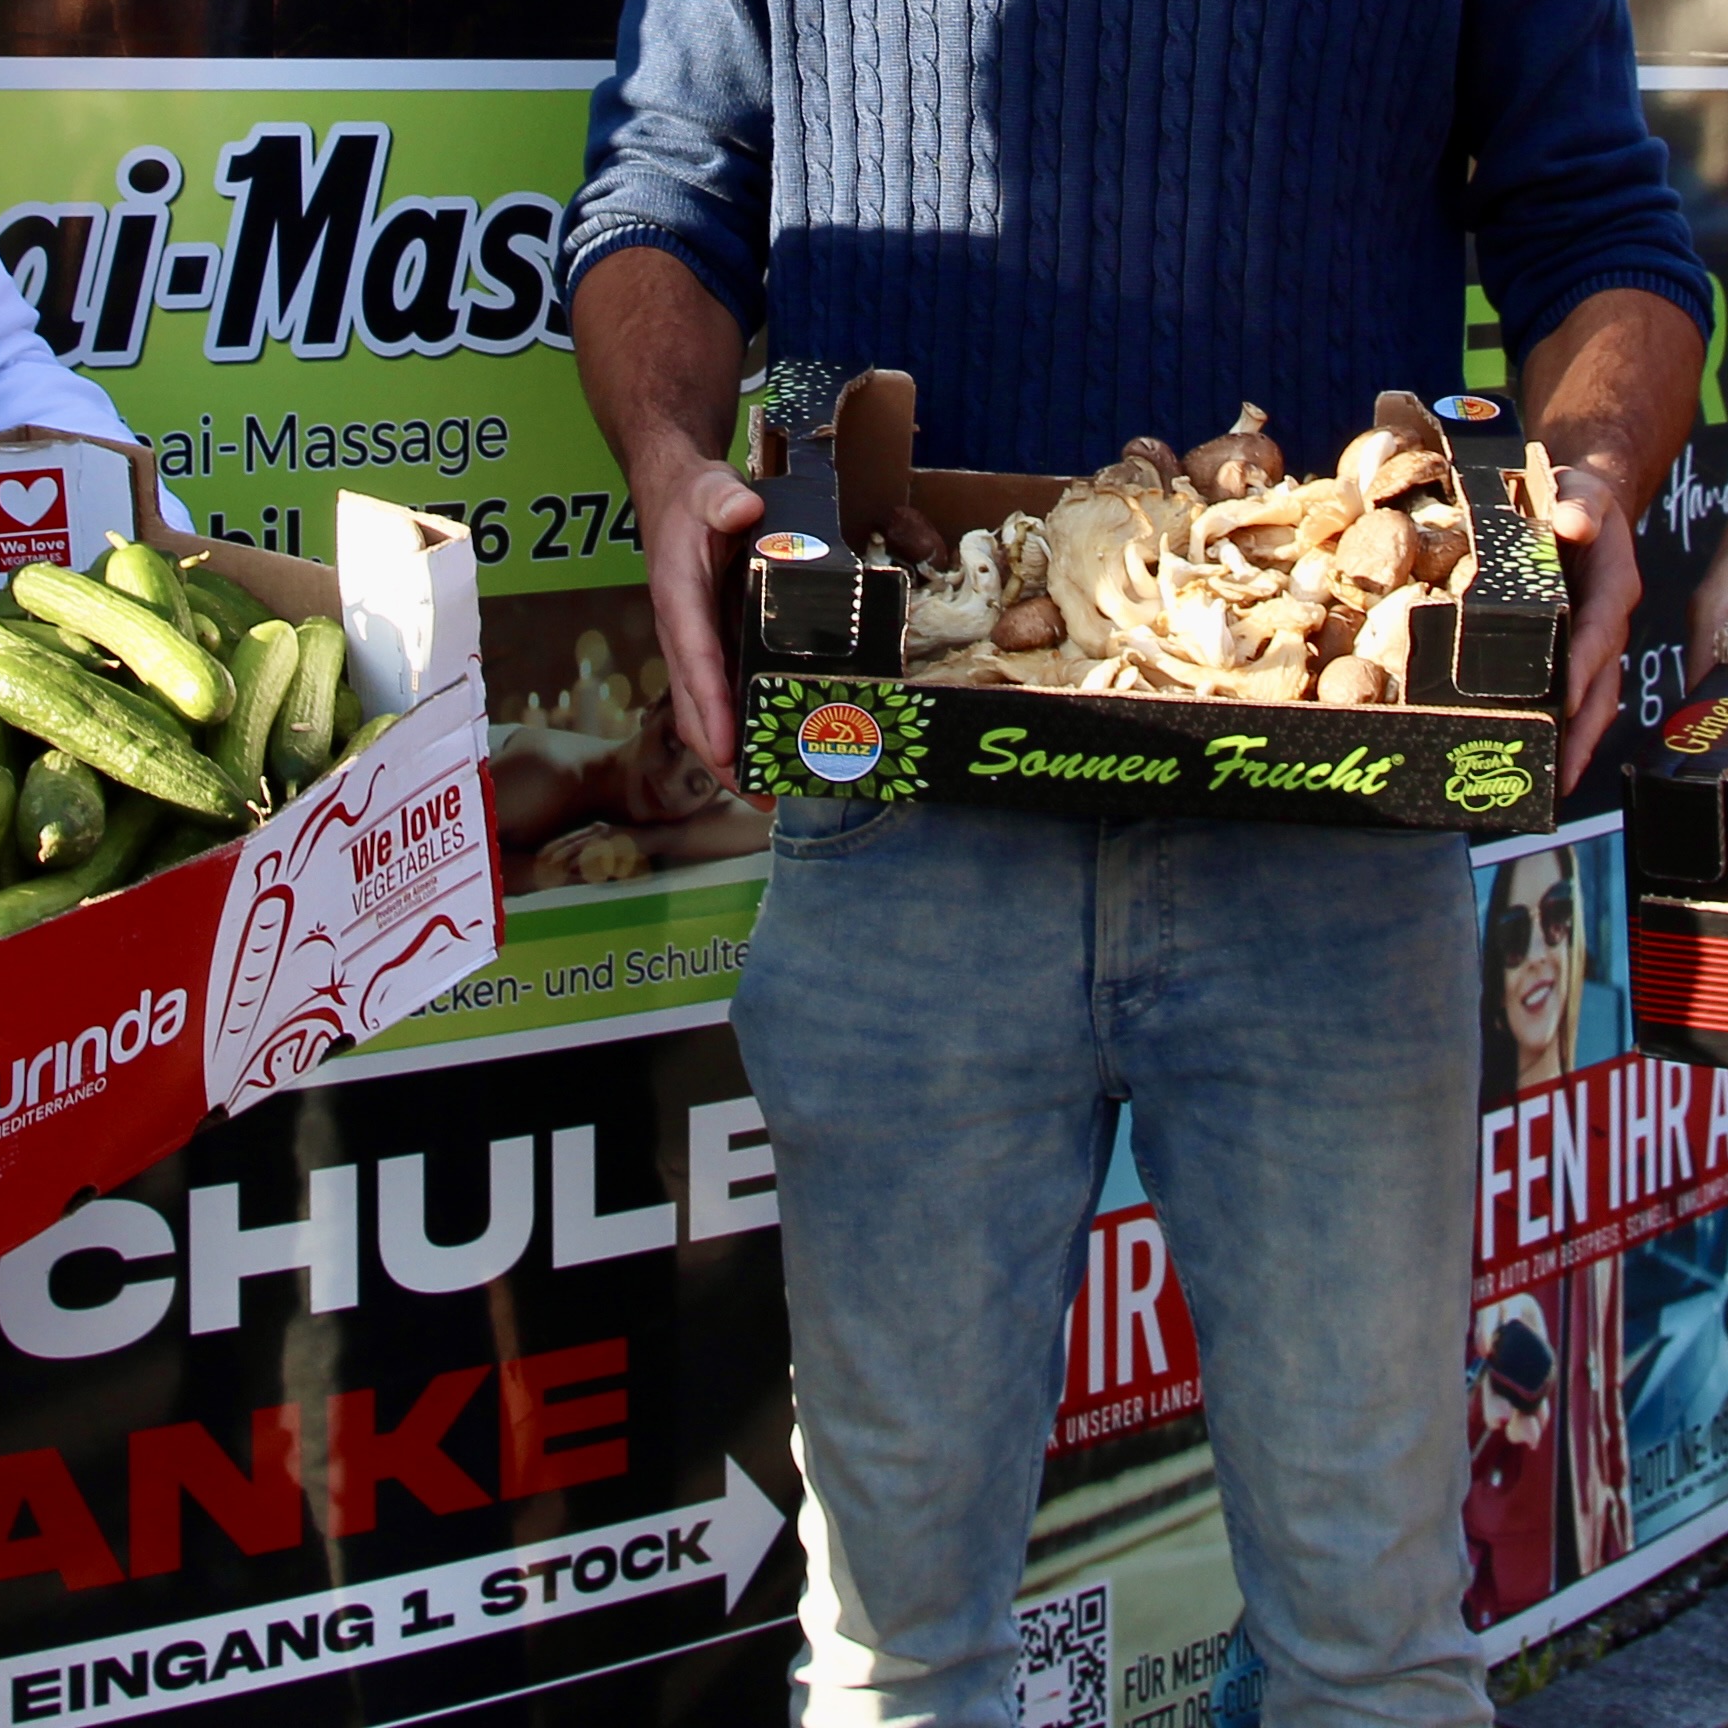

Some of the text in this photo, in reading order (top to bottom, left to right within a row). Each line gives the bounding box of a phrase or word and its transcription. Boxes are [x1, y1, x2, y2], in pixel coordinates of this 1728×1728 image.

[134, 412, 509, 476] ai-Massage
[0, 538, 66, 554] We love
[969, 727, 1181, 784] Sonnen
[350, 784, 462, 885] We love
[351, 821, 466, 916] VEGETABLES
[545, 952, 615, 998] und
[1608, 1057, 1694, 1211] IHR
[1062, 1217, 1169, 1397] IR
[1065, 1395, 1145, 1444] UNSERER
[10, 1518, 714, 1724] EINGANG 1. STOCK
[1124, 1653, 1166, 1710] FÜR
[1172, 1631, 1230, 1691] MEHR
